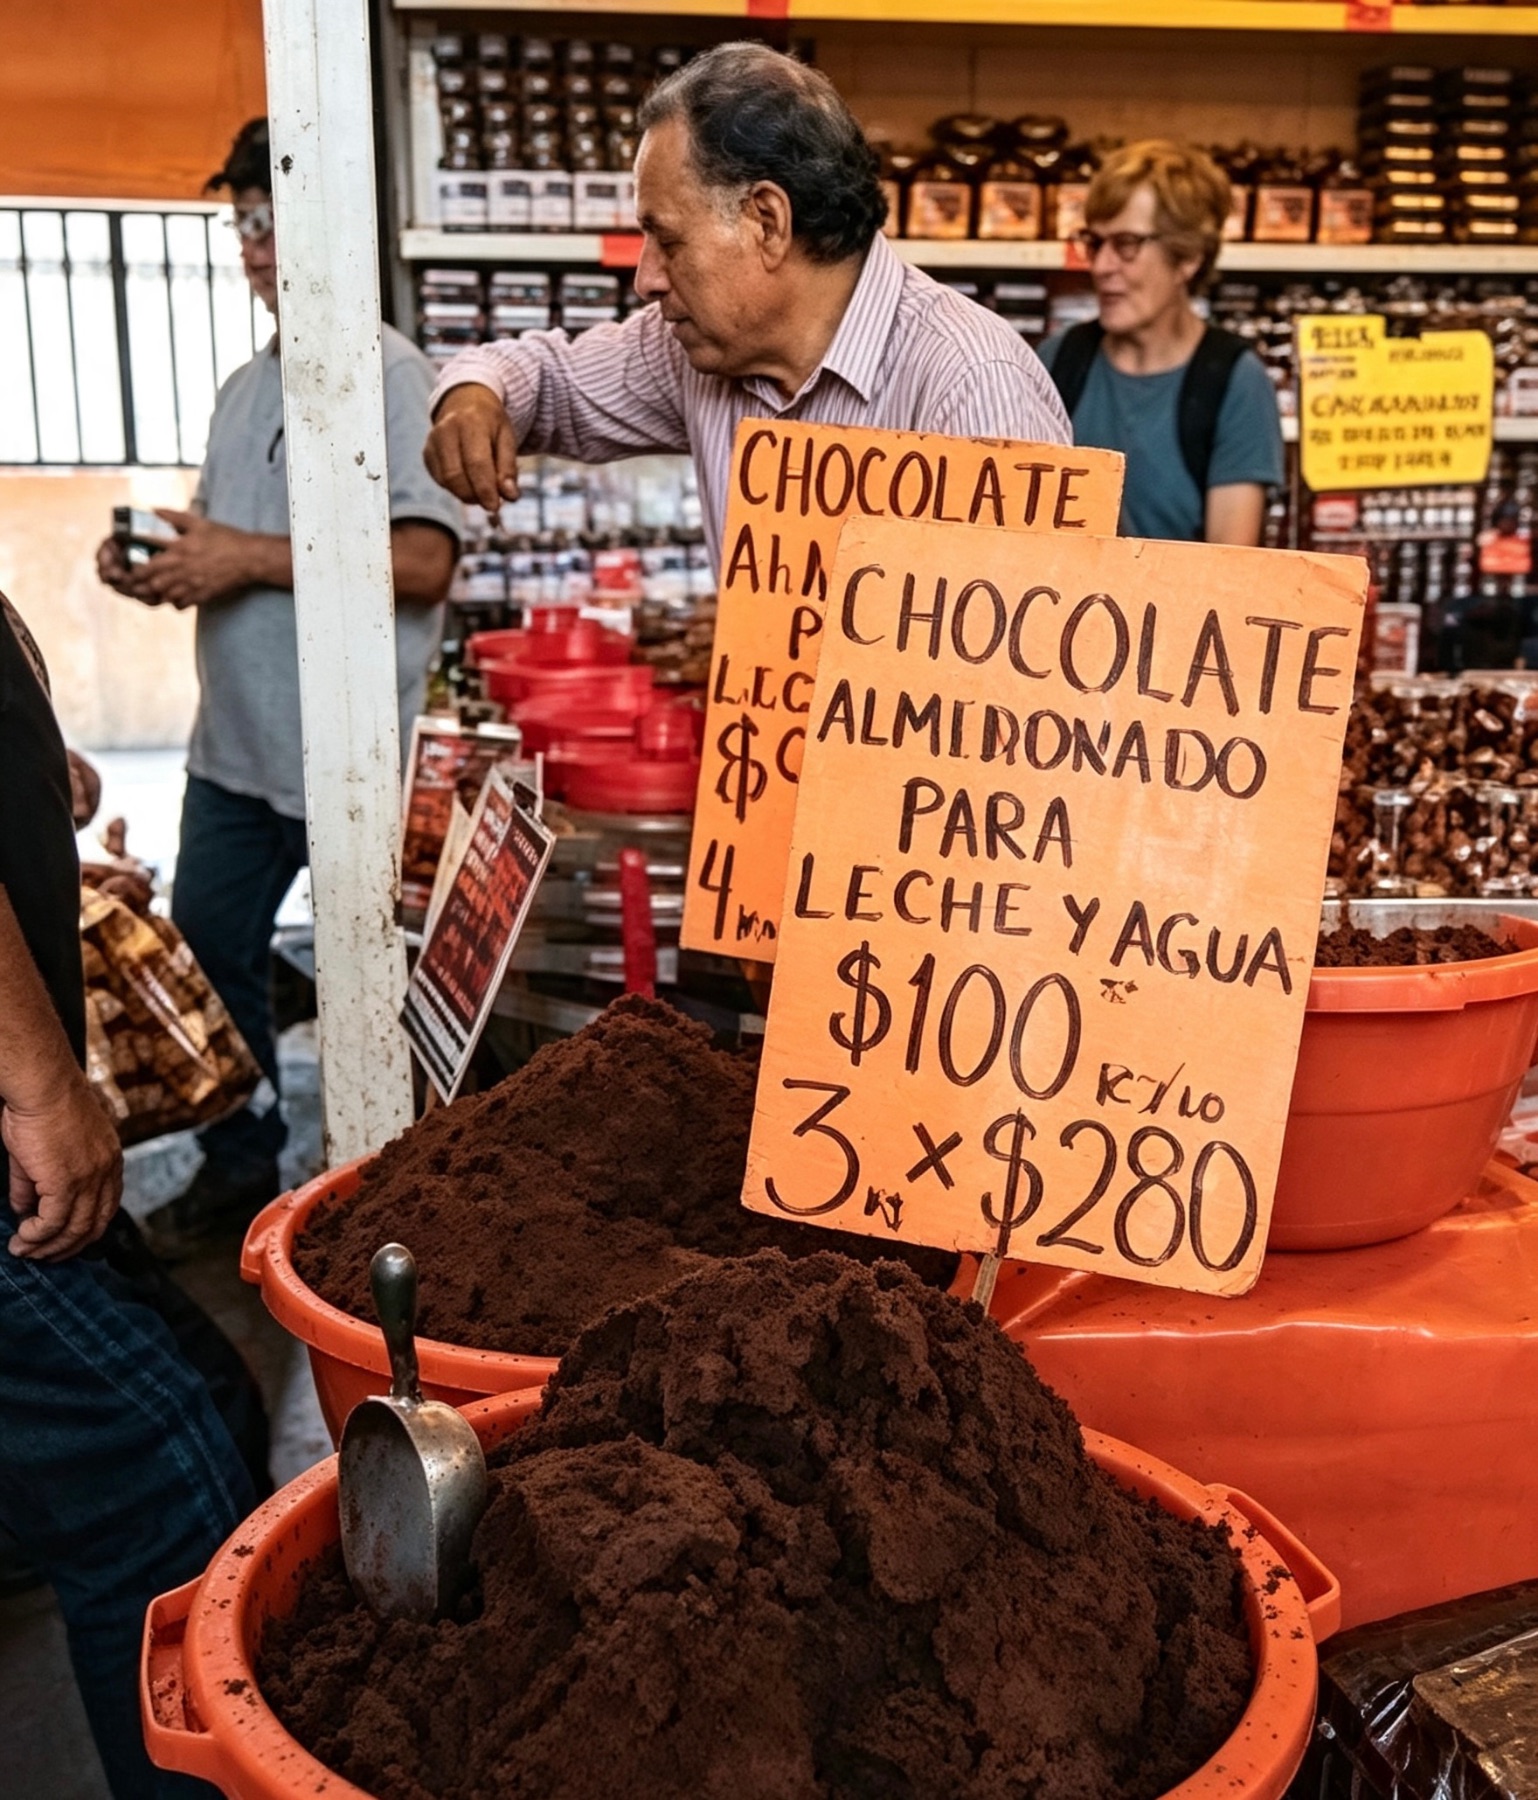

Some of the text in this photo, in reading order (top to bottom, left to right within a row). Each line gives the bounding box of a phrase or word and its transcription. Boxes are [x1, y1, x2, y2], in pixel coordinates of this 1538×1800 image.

[738, 429, 1091, 529] CHOCOLATE
[840, 563, 1353, 717] CHOCOLATE
[816, 678, 1268, 800] ALMIDONADO
[897, 776, 1074, 869] PARA
[698, 838, 736, 941] 4
[794, 852, 1294, 996] LECHE Y AGUA
[828, 939, 1082, 1101] $100
[764, 1077, 861, 1216] 3
[979, 1106, 1258, 1273] $280
